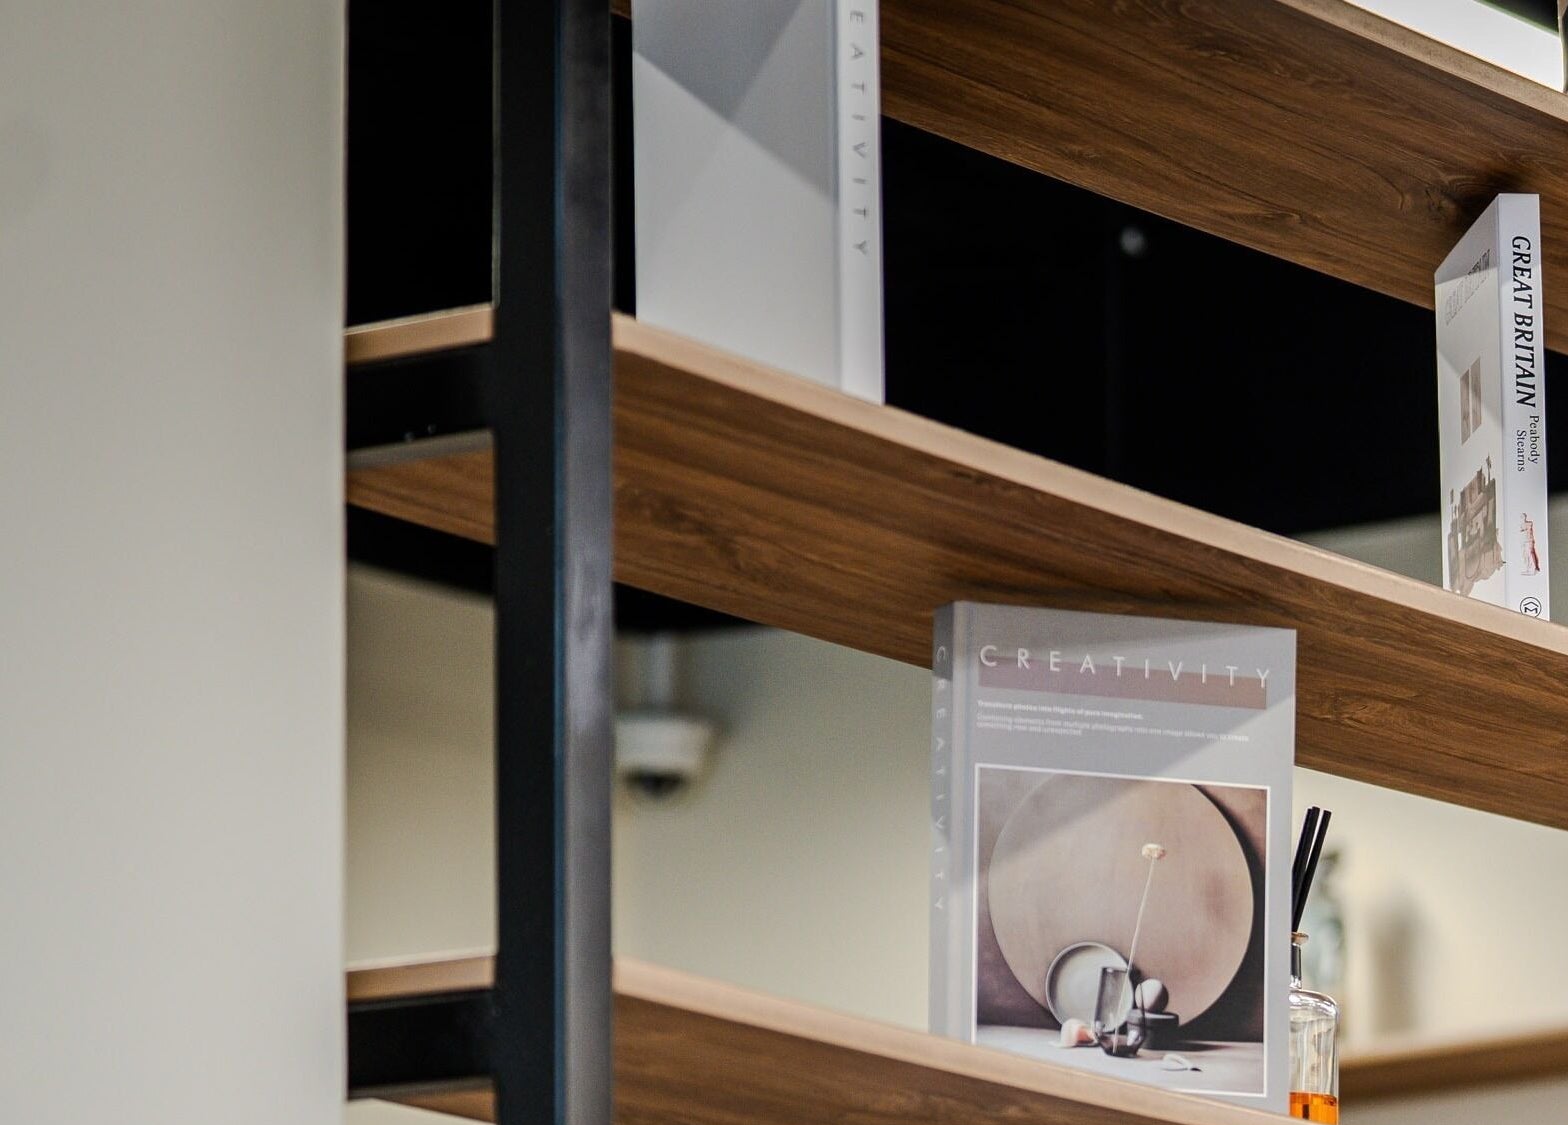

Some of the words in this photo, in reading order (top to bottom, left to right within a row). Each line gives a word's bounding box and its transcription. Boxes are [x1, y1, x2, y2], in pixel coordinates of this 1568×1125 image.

[1511, 235, 1533, 309] GREAT
[1513, 312, 1537, 408] BRITAIN
[1516, 429, 1527, 472] Stearns
[1527, 415, 1541, 465] Peabody
[979, 645, 1270, 689] CREATIVITY
